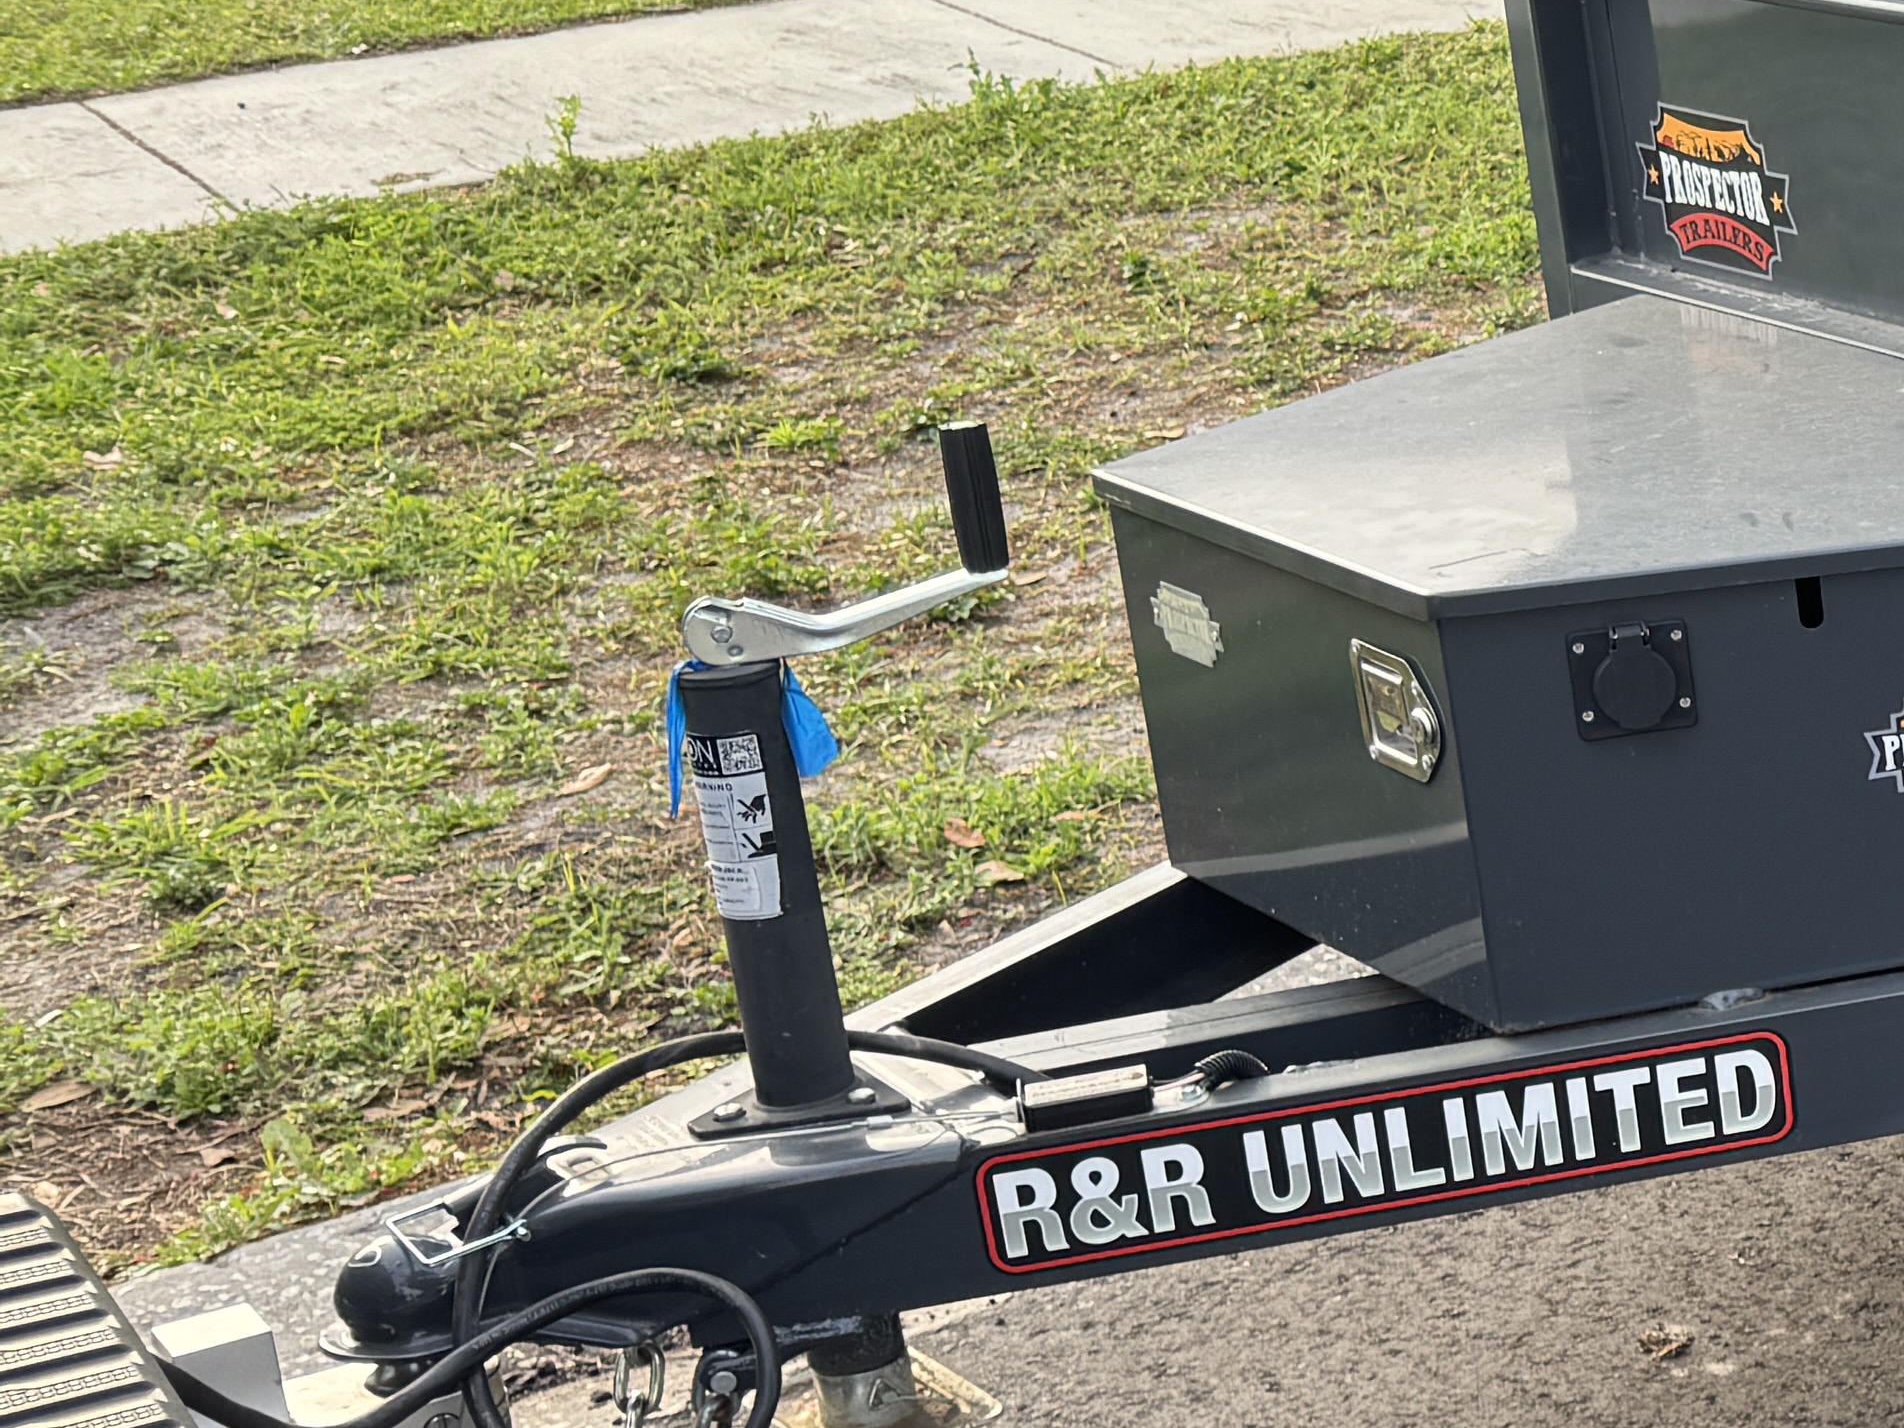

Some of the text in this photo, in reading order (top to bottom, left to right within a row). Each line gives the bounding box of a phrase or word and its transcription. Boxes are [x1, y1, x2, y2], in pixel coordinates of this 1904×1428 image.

[1658, 149, 1771, 227] PROSPECTOR
[1679, 218, 1765, 263] TRAILERS
[990, 1047, 1778, 1259] R&R UNLIMITED
